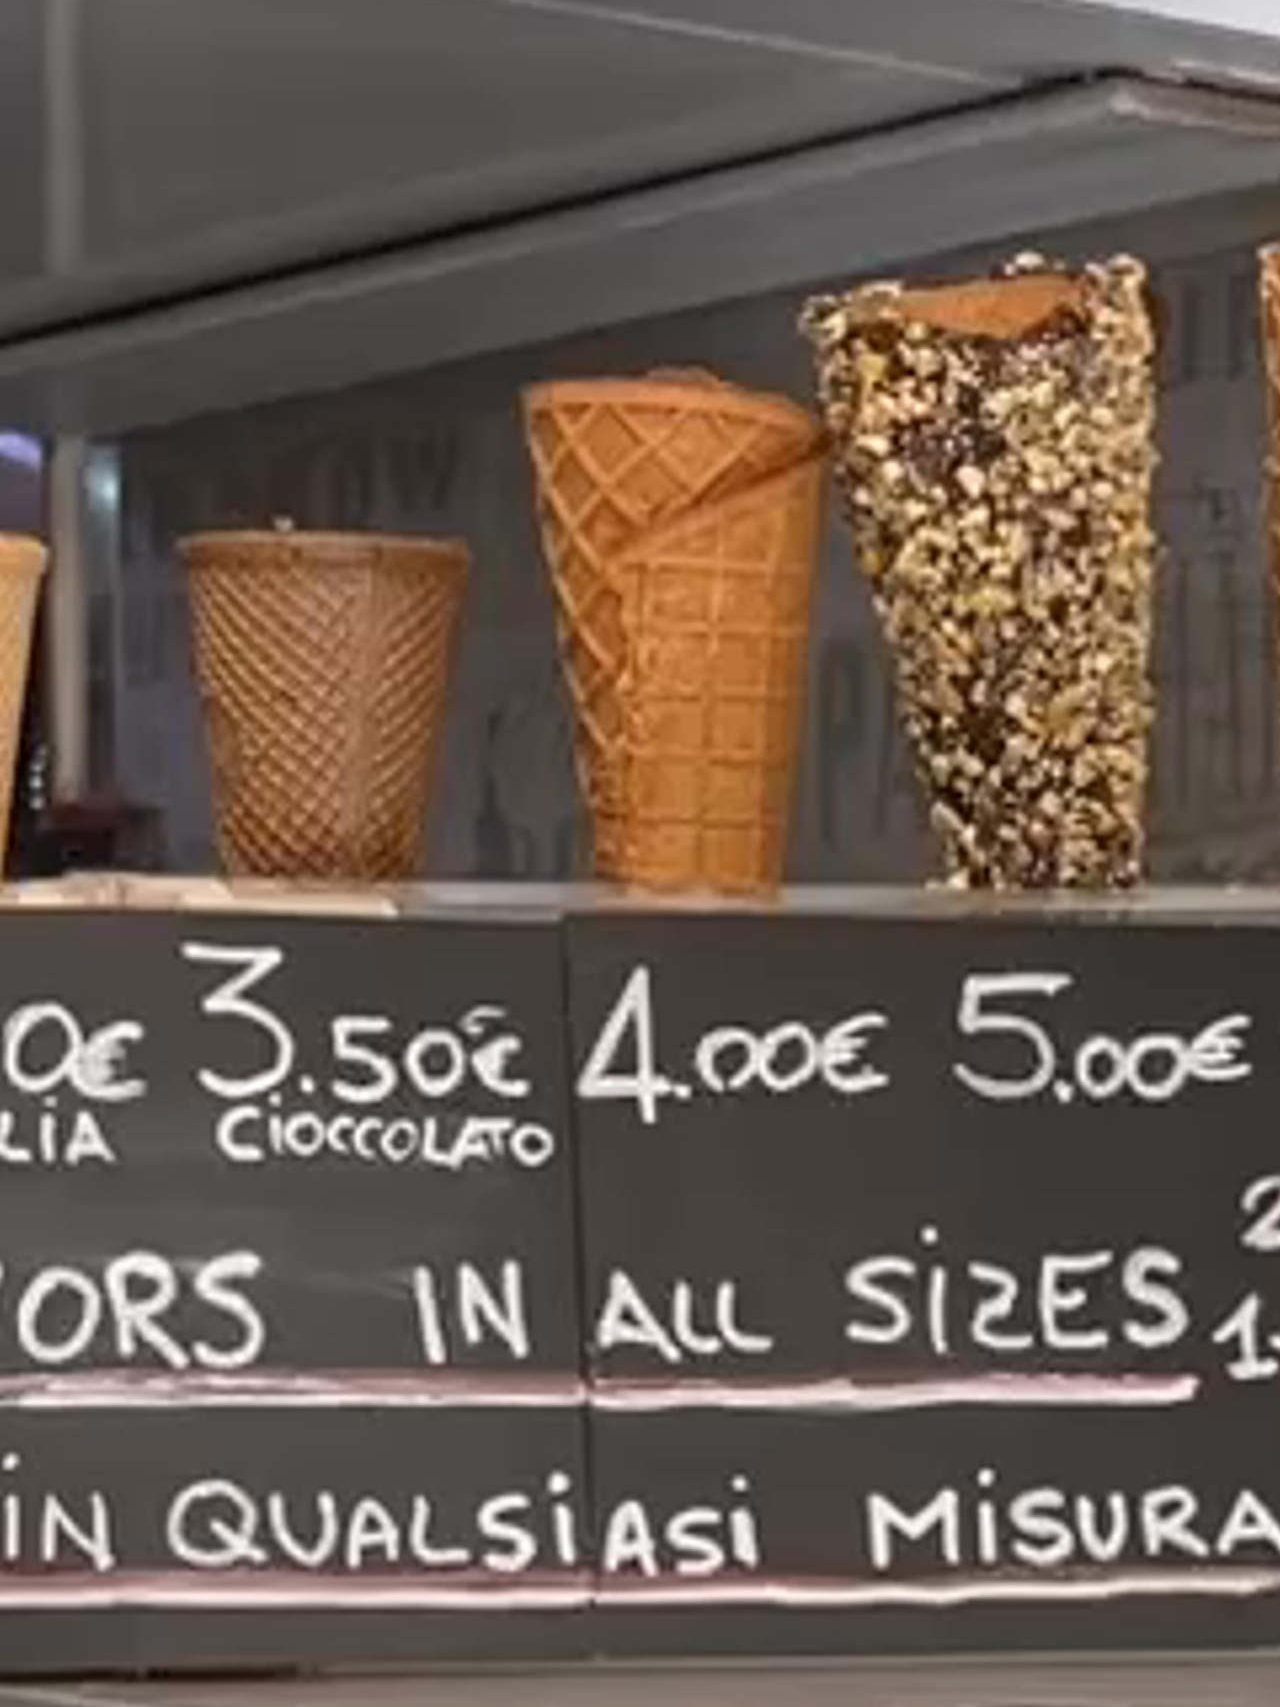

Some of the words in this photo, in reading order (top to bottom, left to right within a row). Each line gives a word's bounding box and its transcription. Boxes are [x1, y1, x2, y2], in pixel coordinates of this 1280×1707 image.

[182, 943, 530, 1099] 3.50€
[578, 966, 889, 1123] 4.00€
[411, 1261, 530, 1365] IN
[595, 1271, 774, 1363] ALL
